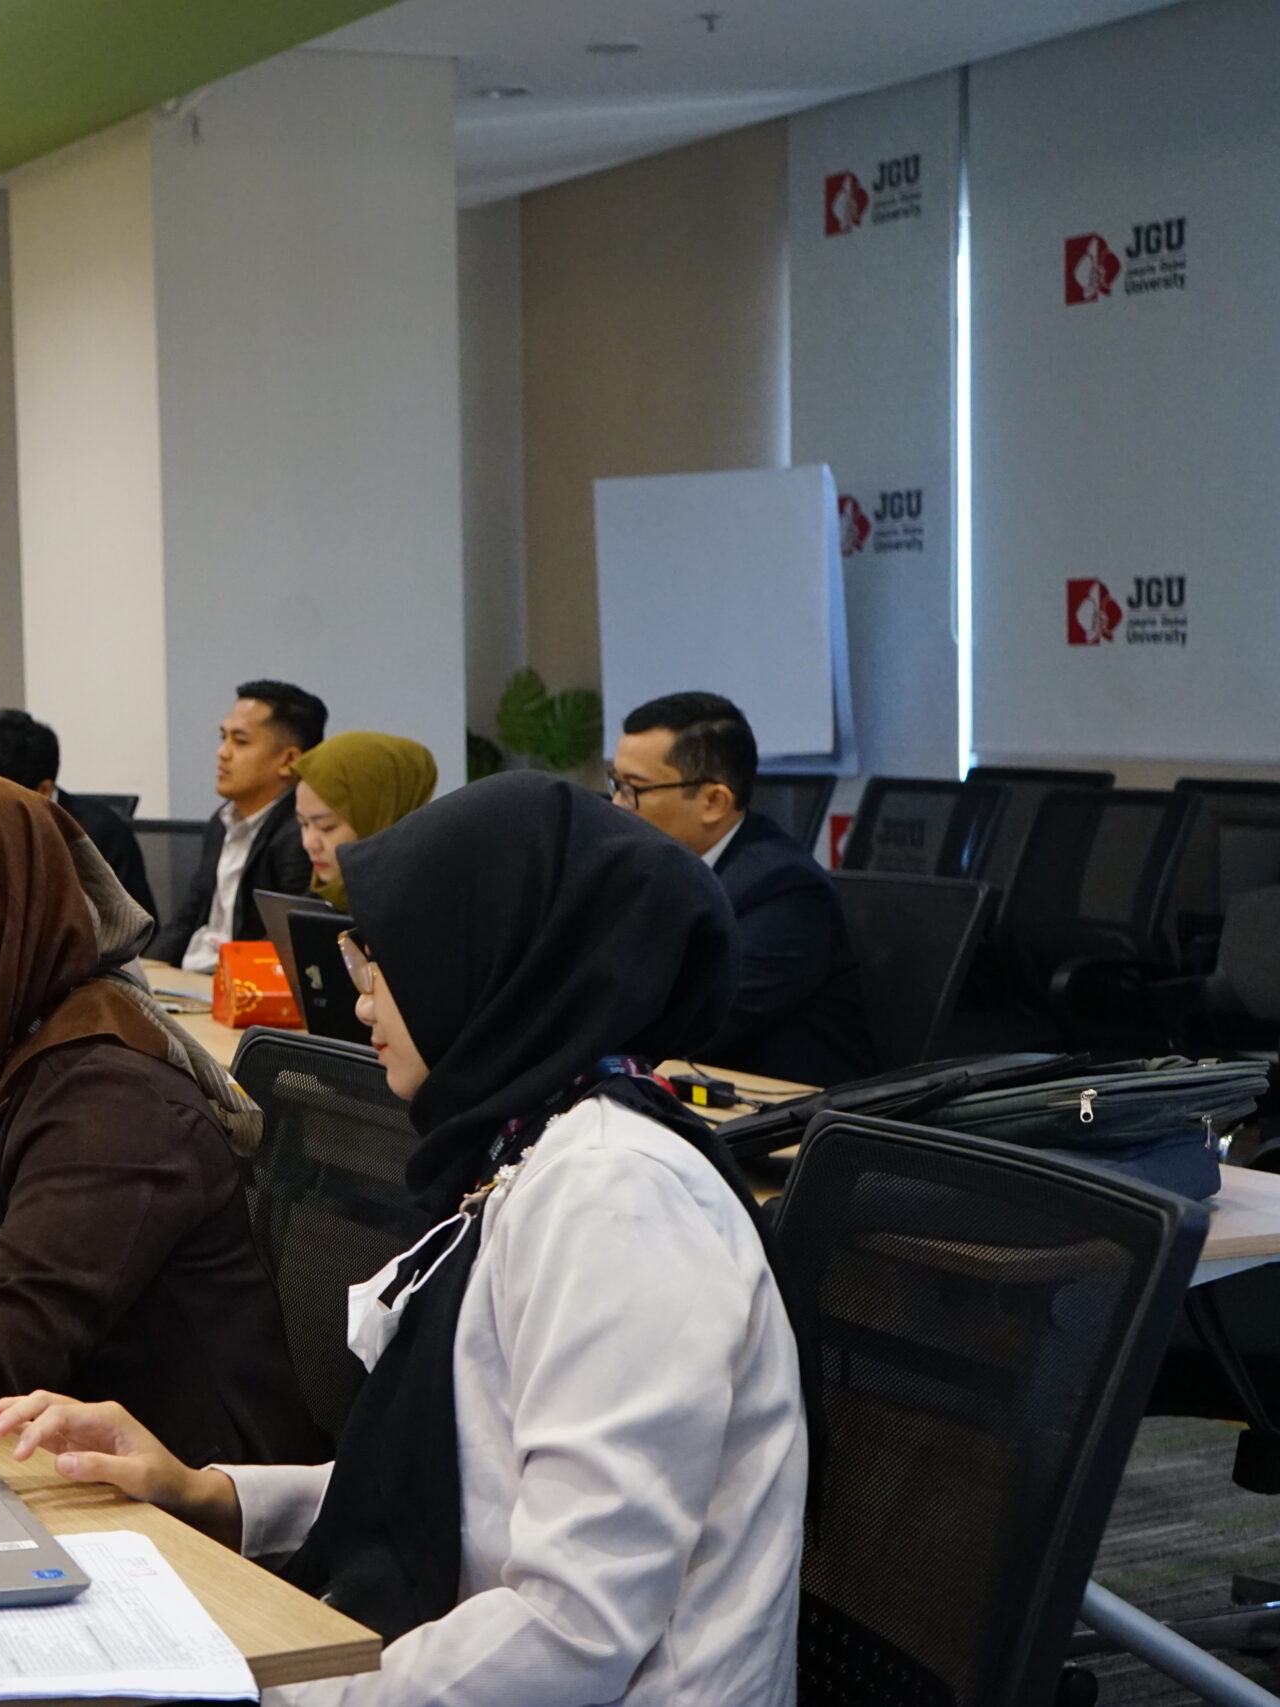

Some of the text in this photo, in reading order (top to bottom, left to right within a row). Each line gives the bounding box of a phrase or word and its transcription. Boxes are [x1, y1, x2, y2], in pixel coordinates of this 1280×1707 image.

[873, 154, 921, 192] JGU
[1125, 218, 1185, 258] JGU
[874, 490, 922, 519] JGU
[1126, 576, 1185, 608] JGU
